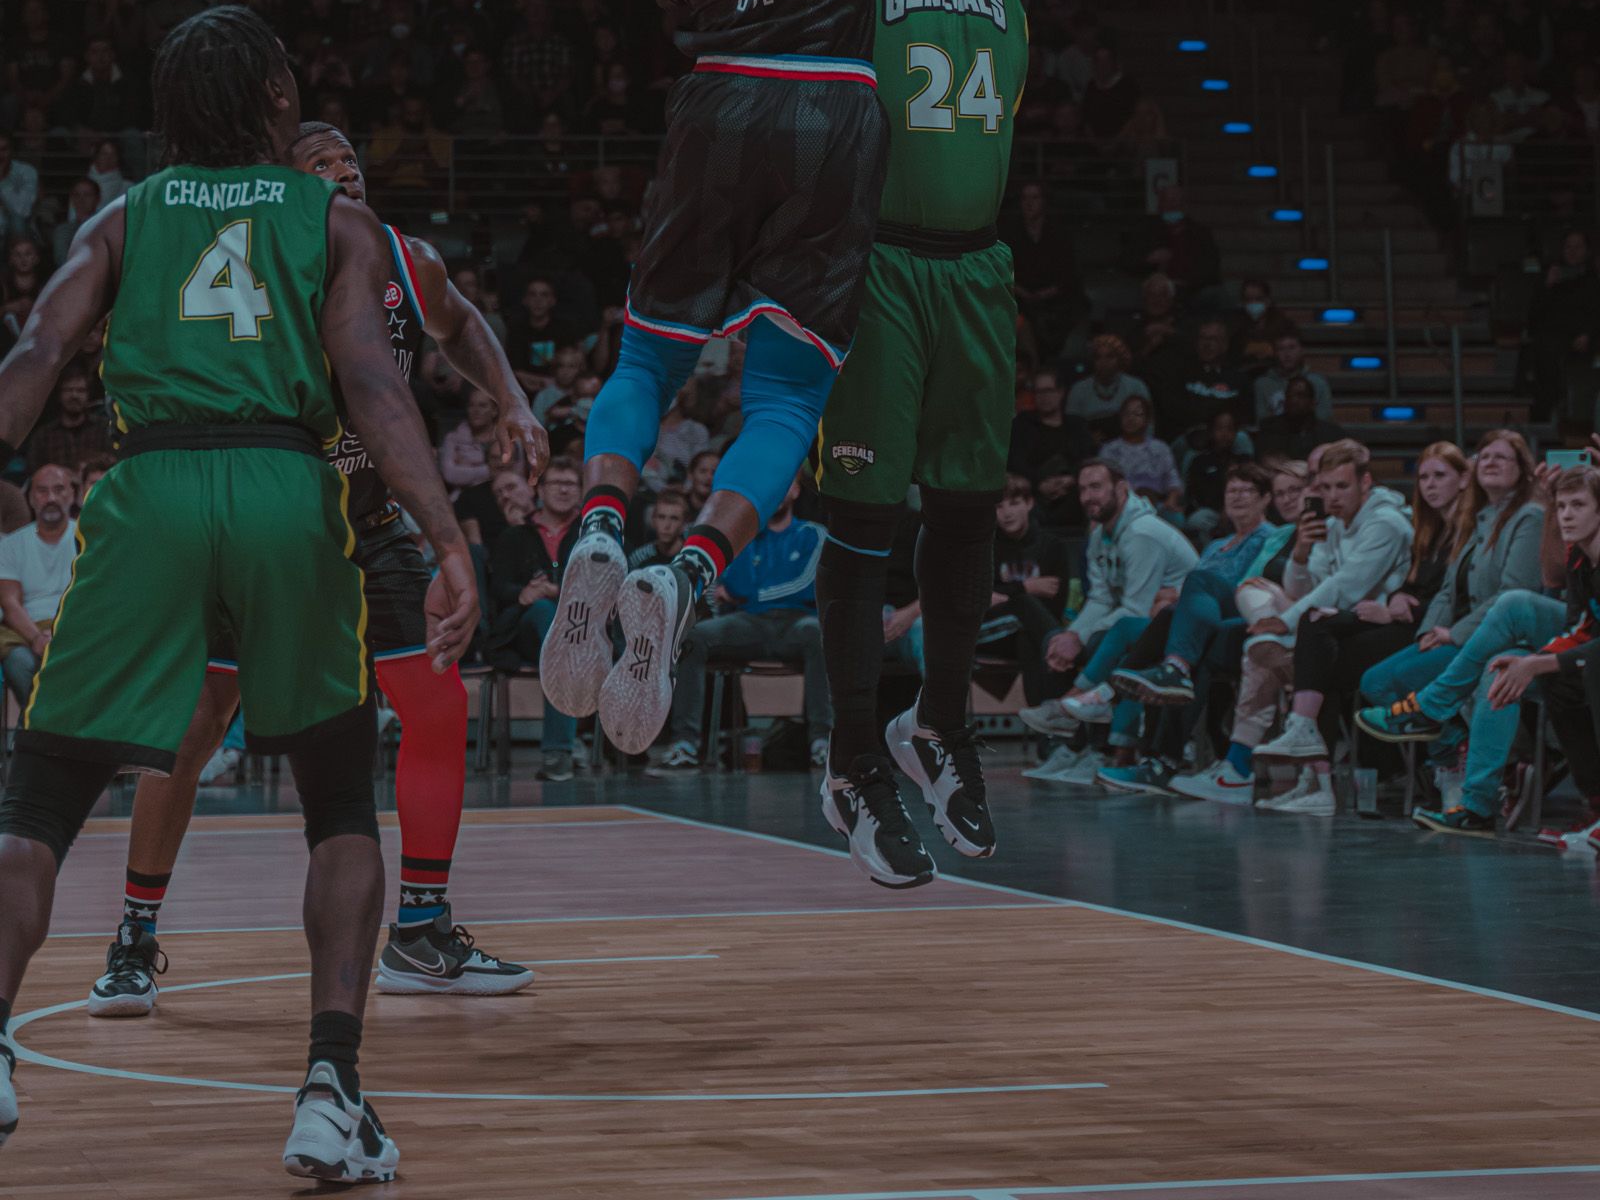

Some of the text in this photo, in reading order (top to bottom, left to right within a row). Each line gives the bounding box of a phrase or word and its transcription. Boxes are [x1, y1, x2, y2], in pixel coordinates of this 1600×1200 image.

[906, 42, 1004, 134] 24
[164, 178, 286, 212] CHANDLER
[179, 218, 274, 342] 4
[832, 445, 875, 464] GENERALS
